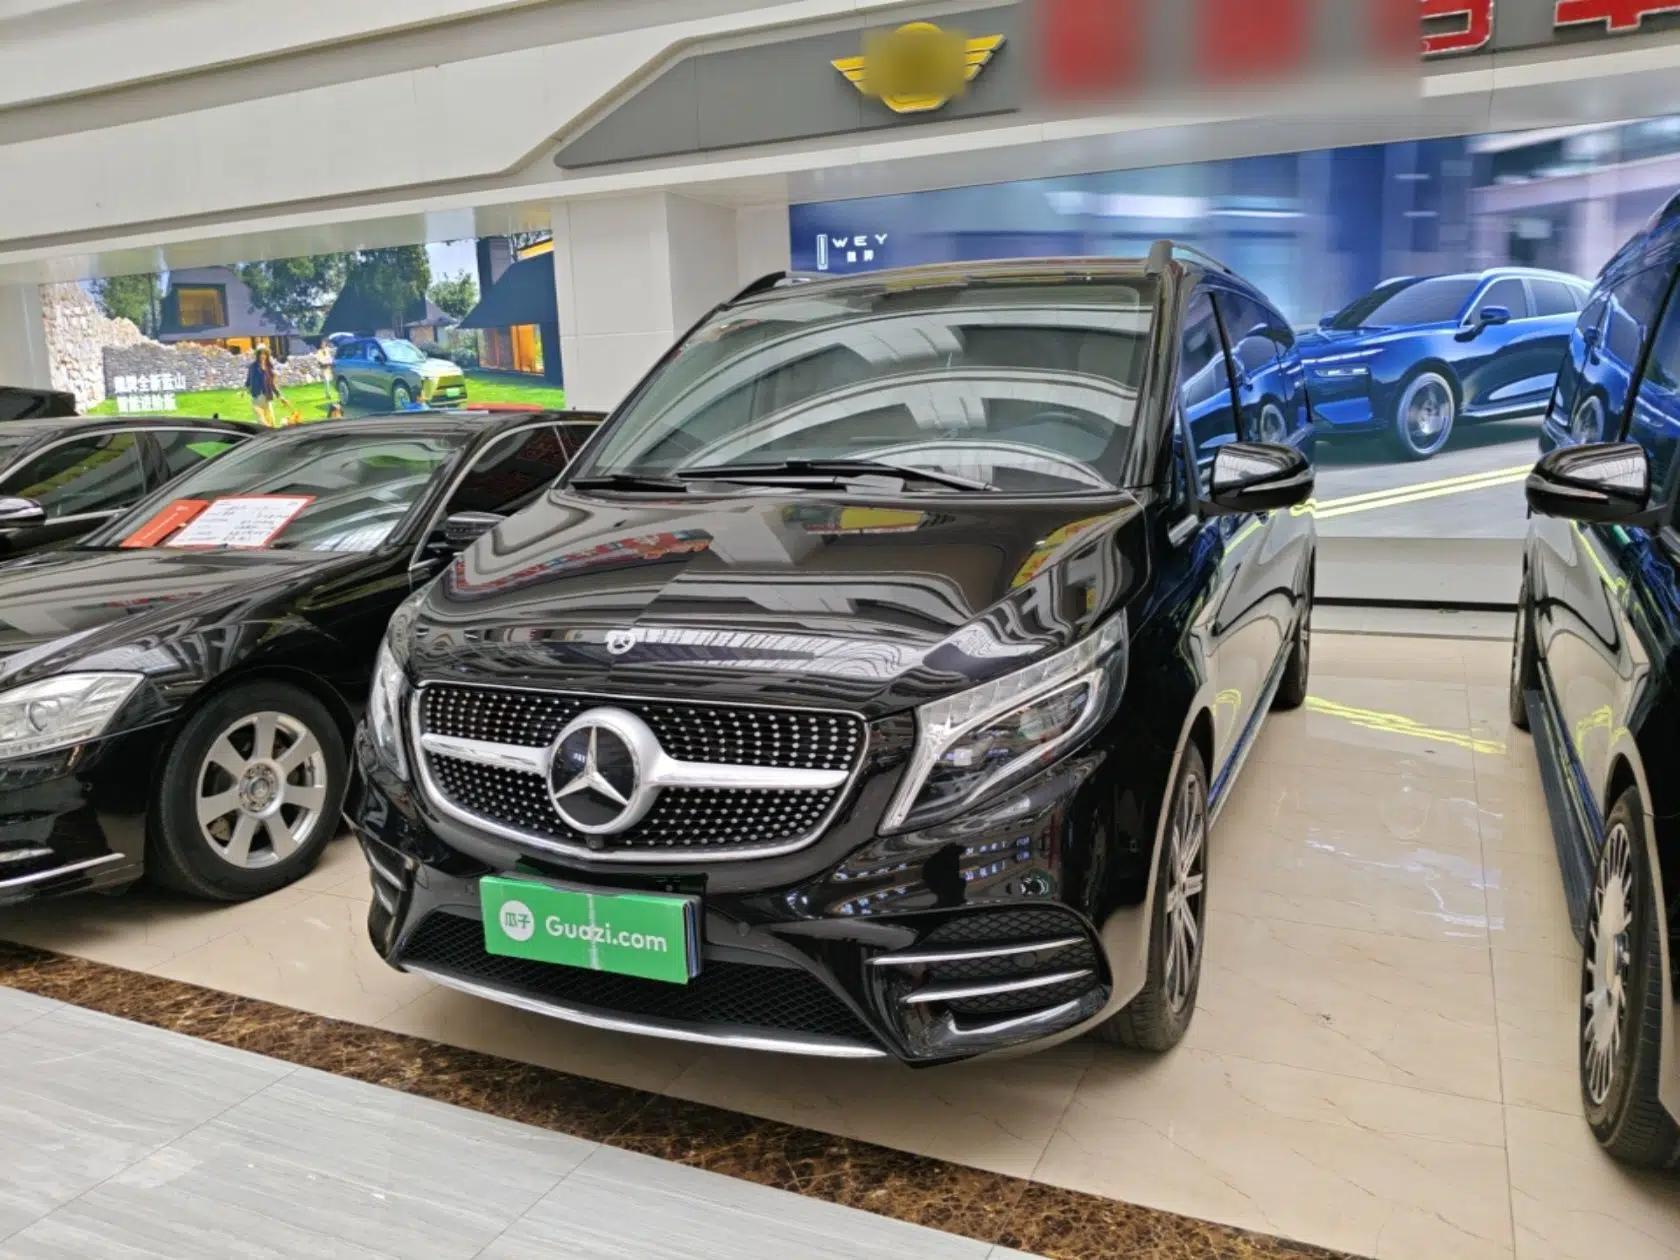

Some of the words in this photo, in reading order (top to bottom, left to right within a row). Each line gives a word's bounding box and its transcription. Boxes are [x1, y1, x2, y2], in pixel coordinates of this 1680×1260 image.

[831, 233, 888, 248] WEY
[504, 911, 531, 930] 瓜子
[545, 915, 668, 953] Guazi.com
